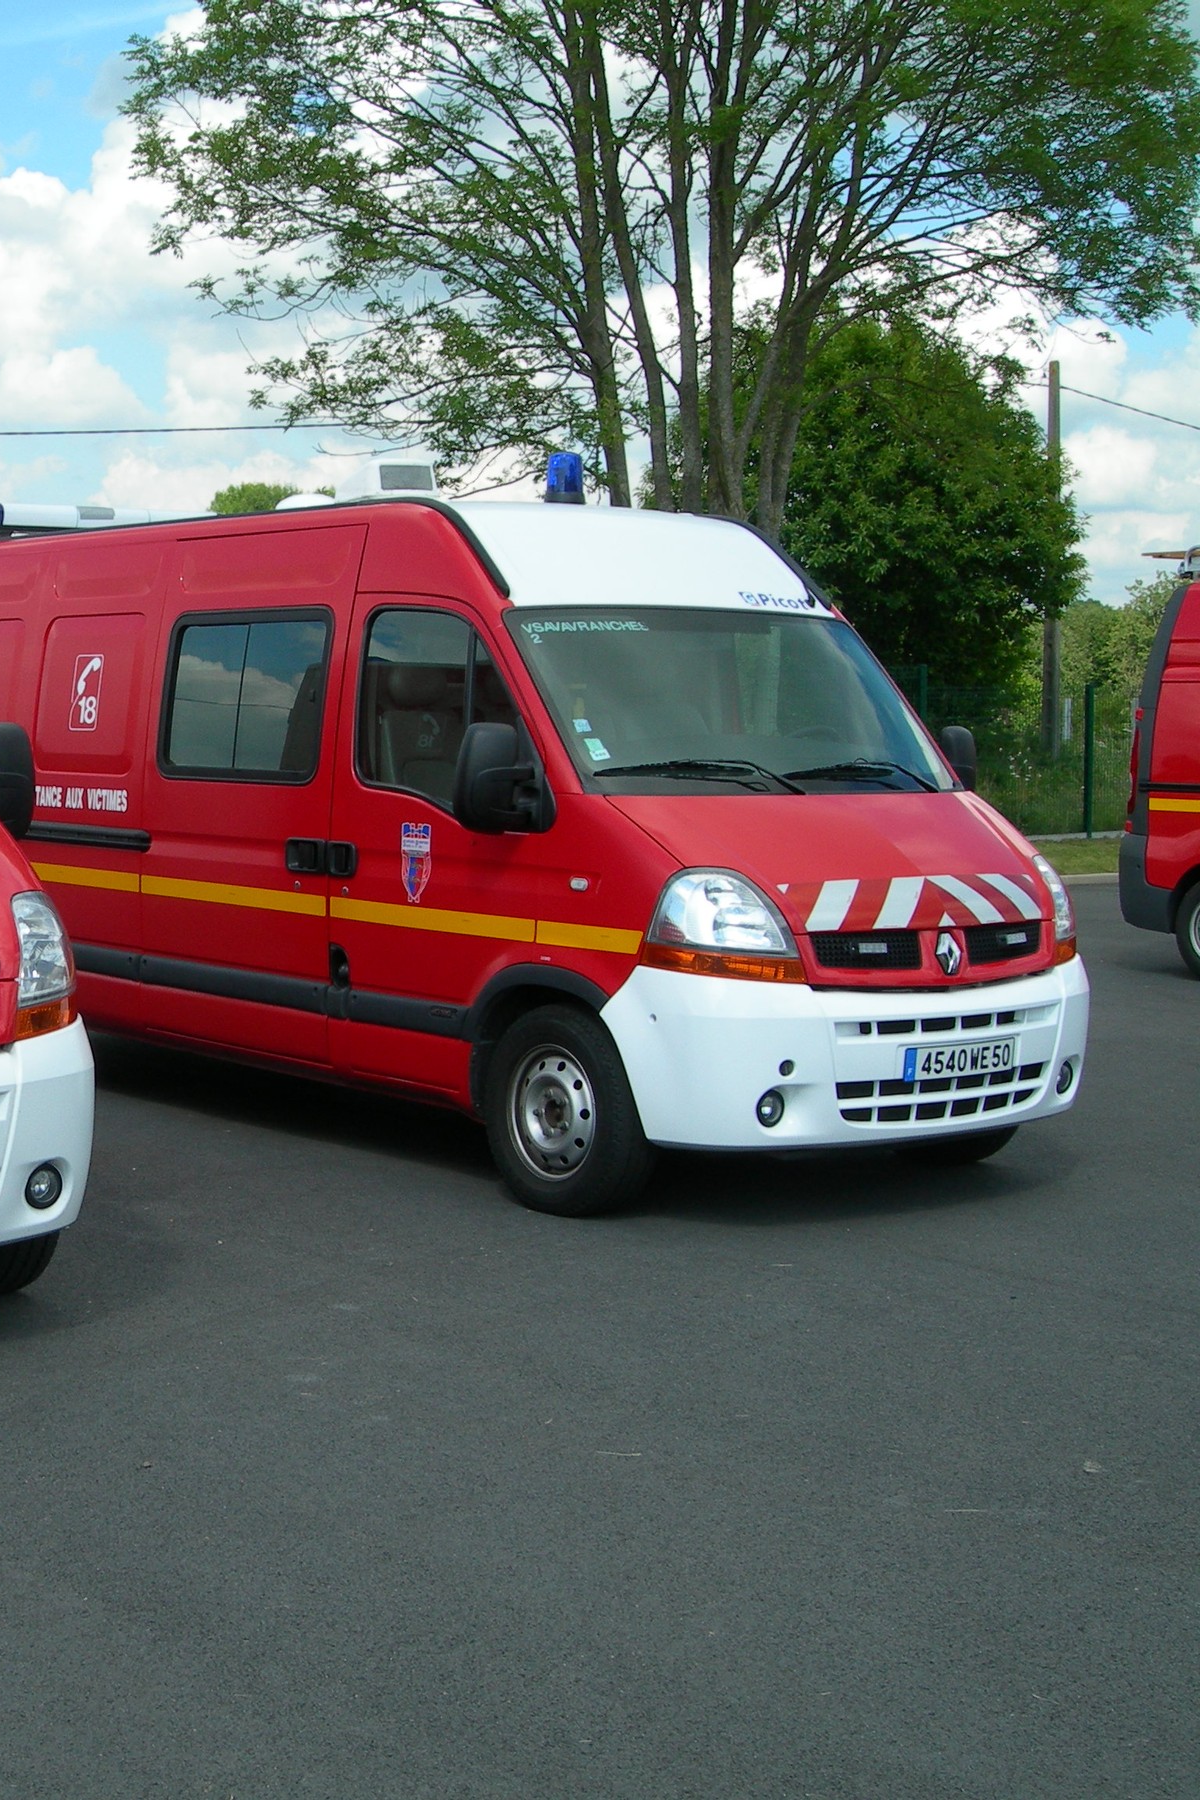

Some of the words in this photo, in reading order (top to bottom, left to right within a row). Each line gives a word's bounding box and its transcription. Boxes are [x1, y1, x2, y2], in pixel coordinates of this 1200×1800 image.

[757, 592, 809, 611] Picot
[530, 633, 543, 644] 2
[78, 695, 97, 724] 18
[65, 787, 84, 810] AUX
[87, 788, 128, 813] VICTIMES
